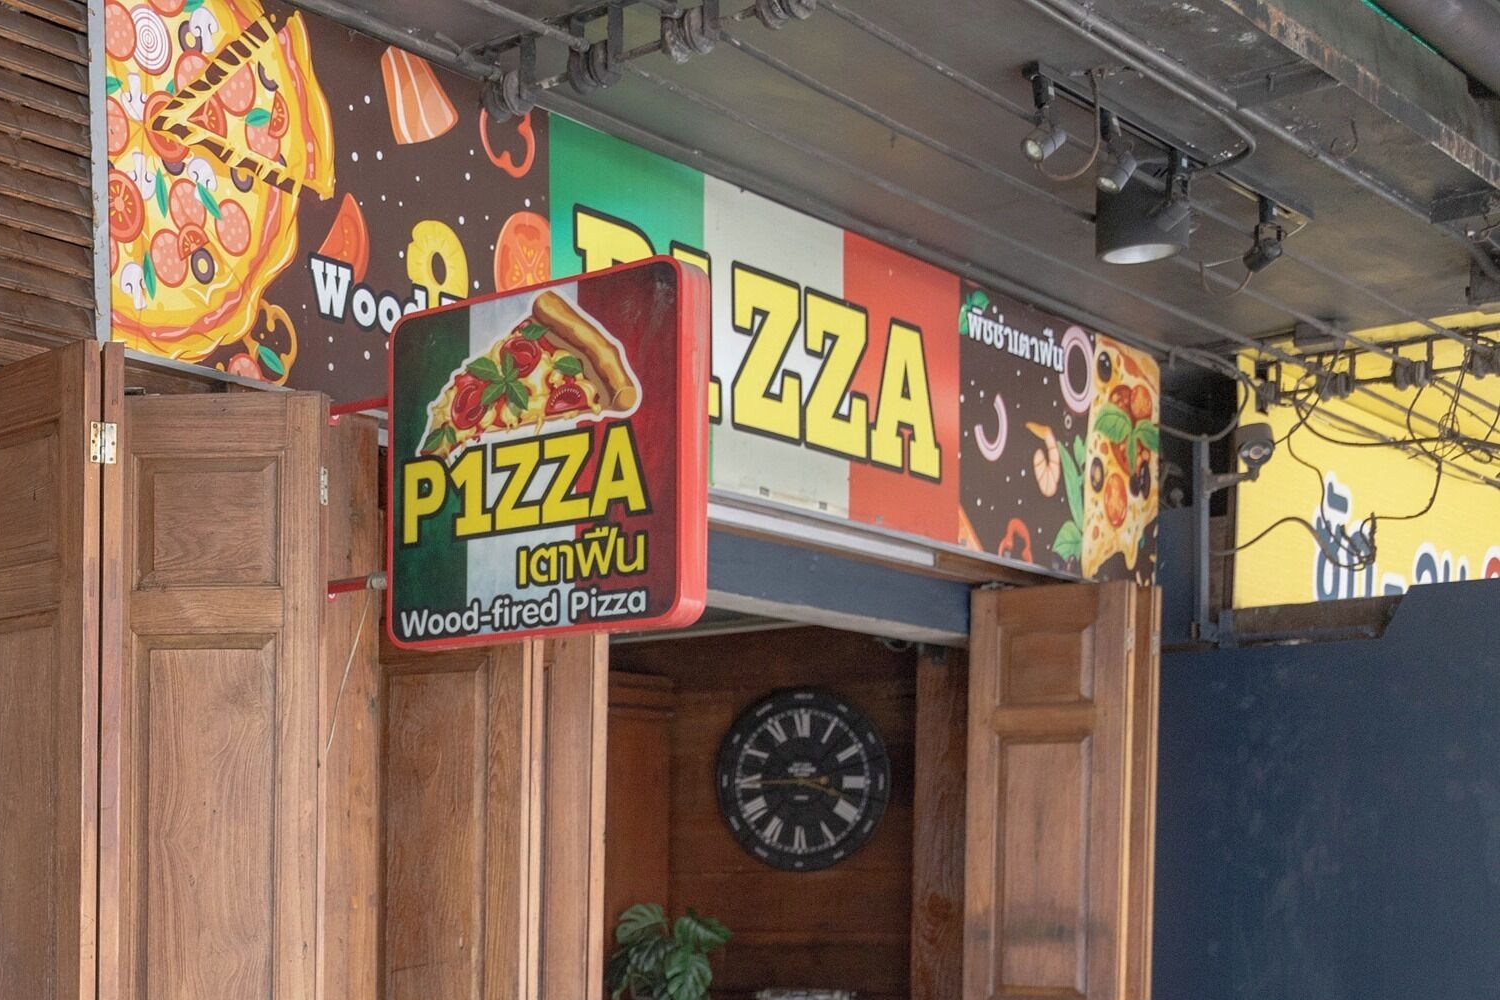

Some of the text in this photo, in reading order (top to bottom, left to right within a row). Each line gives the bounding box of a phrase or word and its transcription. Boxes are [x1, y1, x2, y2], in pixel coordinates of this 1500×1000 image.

[518, 526, 646, 586] เตาฟืน
[401, 588, 647, 637] Wood-fired Pizza
